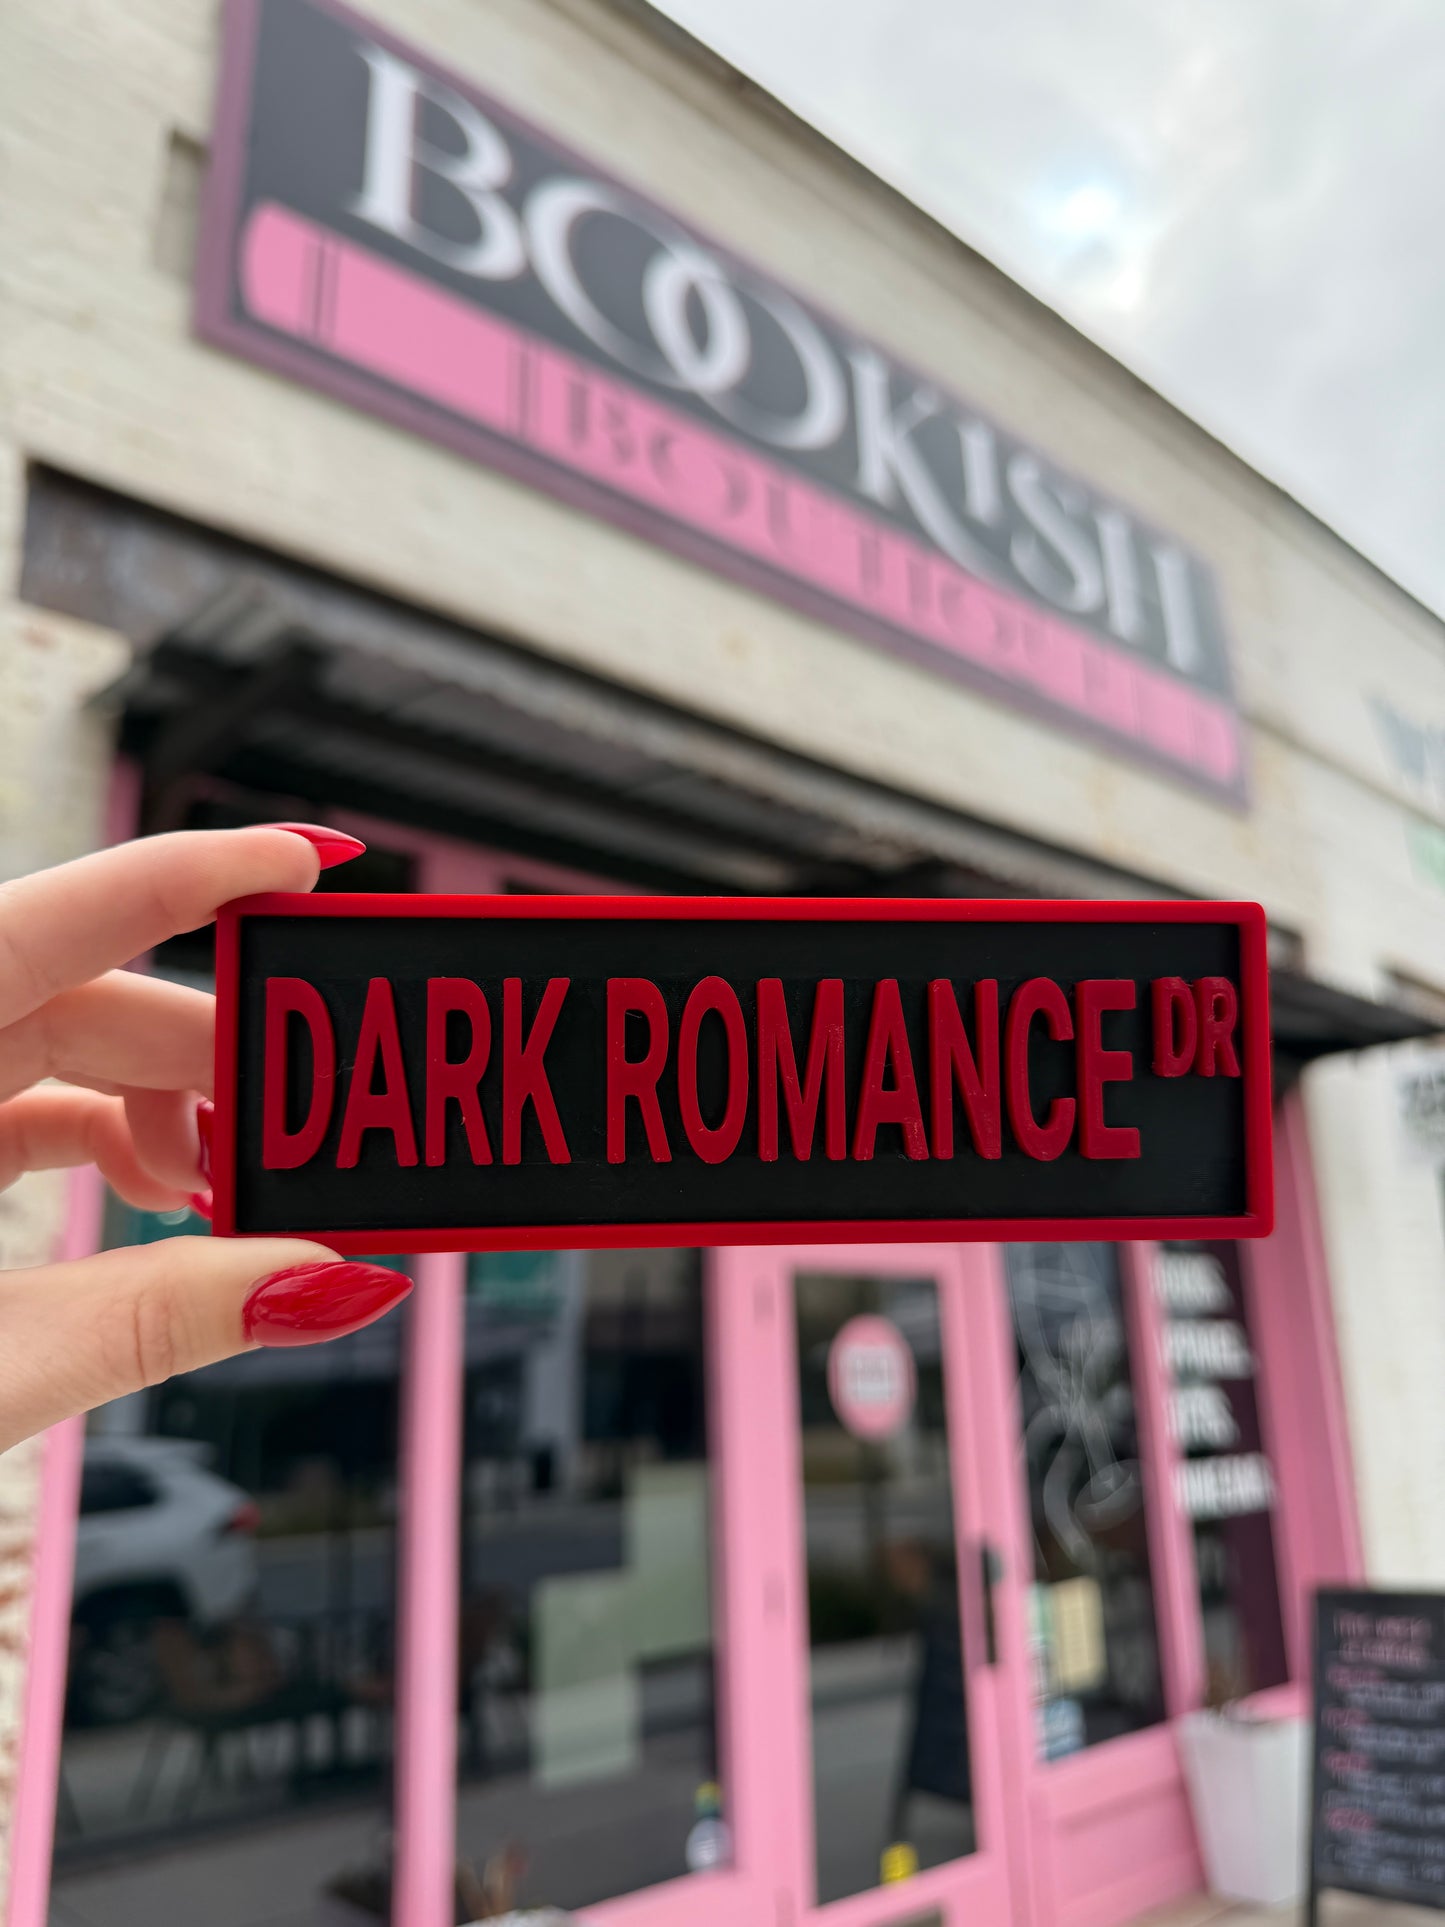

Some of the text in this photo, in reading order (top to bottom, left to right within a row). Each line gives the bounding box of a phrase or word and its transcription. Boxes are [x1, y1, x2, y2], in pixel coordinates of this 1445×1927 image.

[350, 43, 1200, 673] BOOKISH
[263, 976, 1241, 1169] DARK ROMANCE DR
